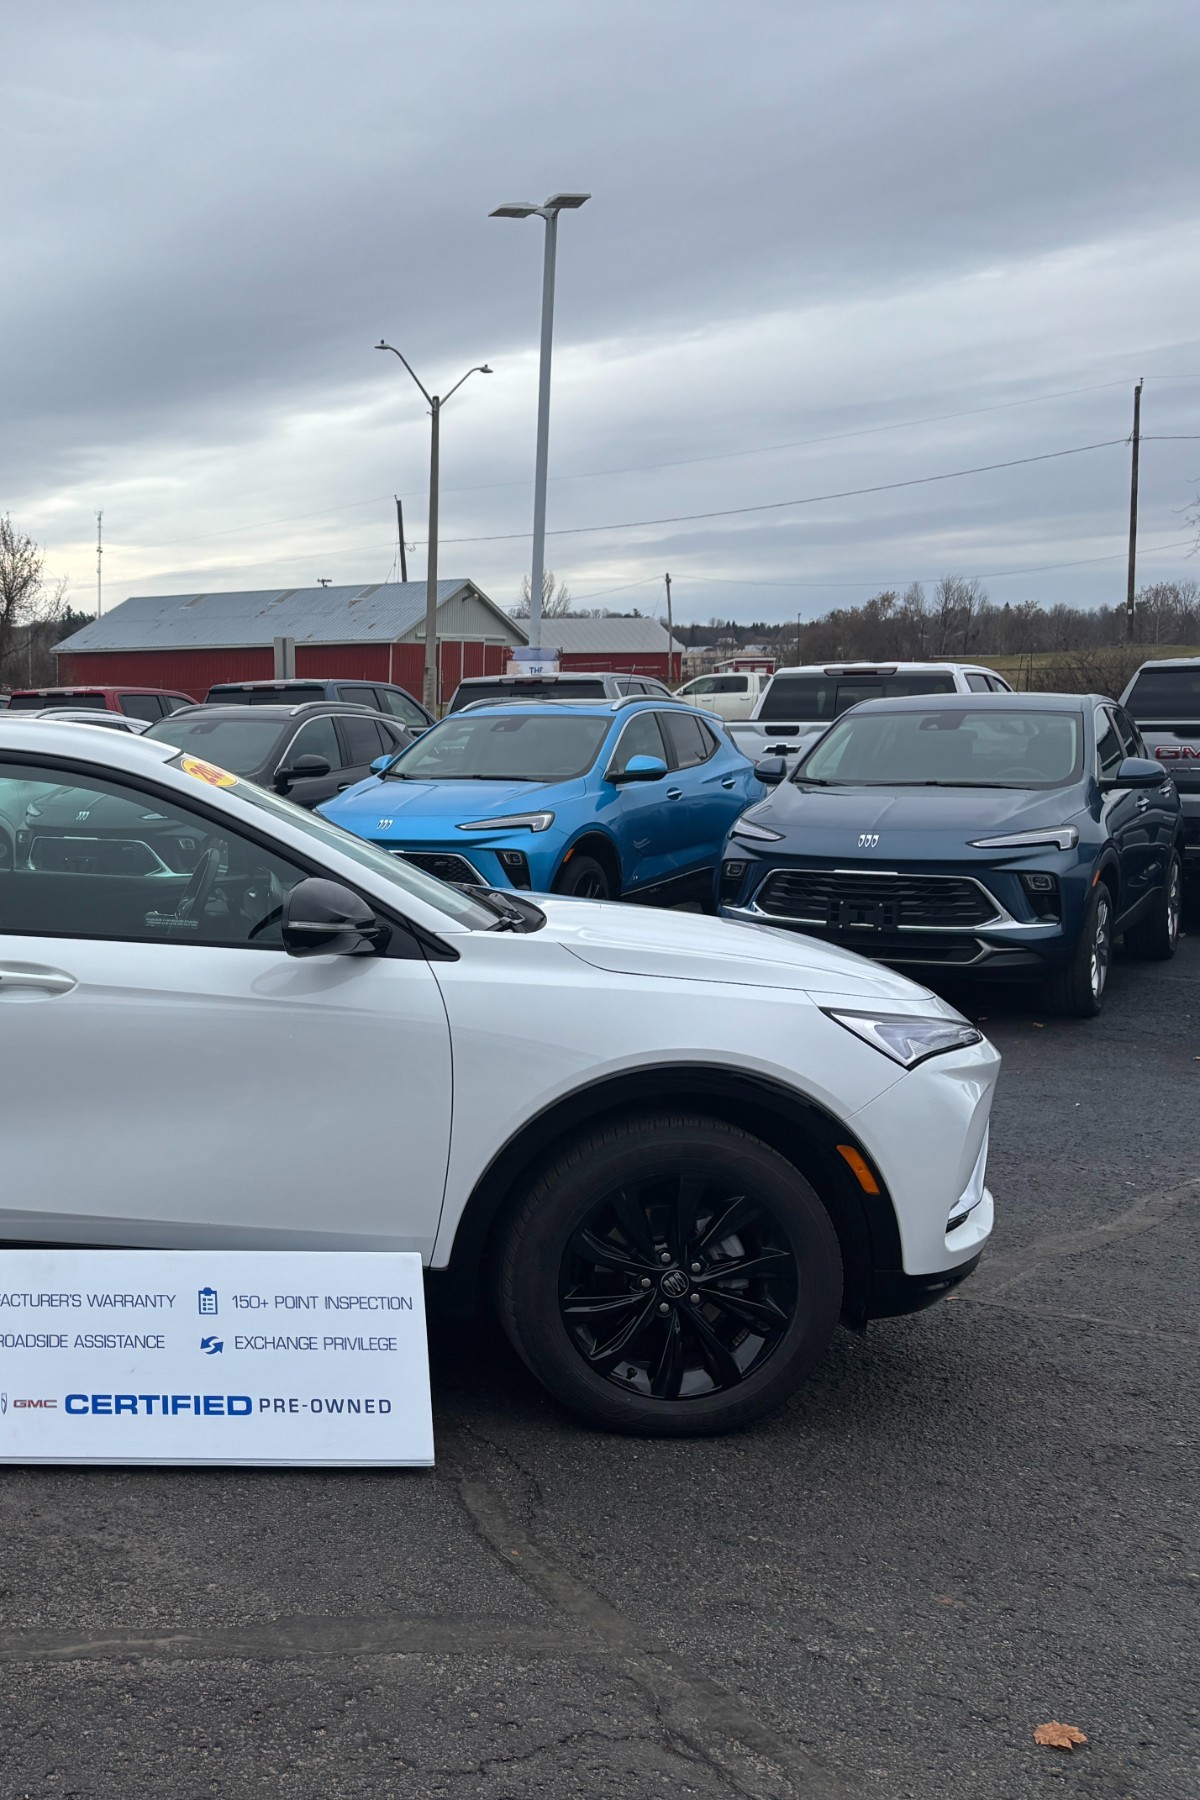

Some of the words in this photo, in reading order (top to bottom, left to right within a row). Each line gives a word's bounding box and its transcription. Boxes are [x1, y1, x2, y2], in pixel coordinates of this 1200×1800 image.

[86, 1293, 177, 1309] WARRANTY
[231, 1295, 269, 1309] 150+
[274, 1295, 319, 1310] POINT
[324, 1296, 413, 1311] INSPECTION
[73, 1334, 166, 1349] ASSISTANCE
[234, 1335, 318, 1350] EXCHANGE
[323, 1336, 398, 1351] PRIVILEGE
[13, 1399, 58, 1409] GMC
[64, 1393, 253, 1416] CERTIFIED
[259, 1397, 392, 1414] PRE-OWNED
